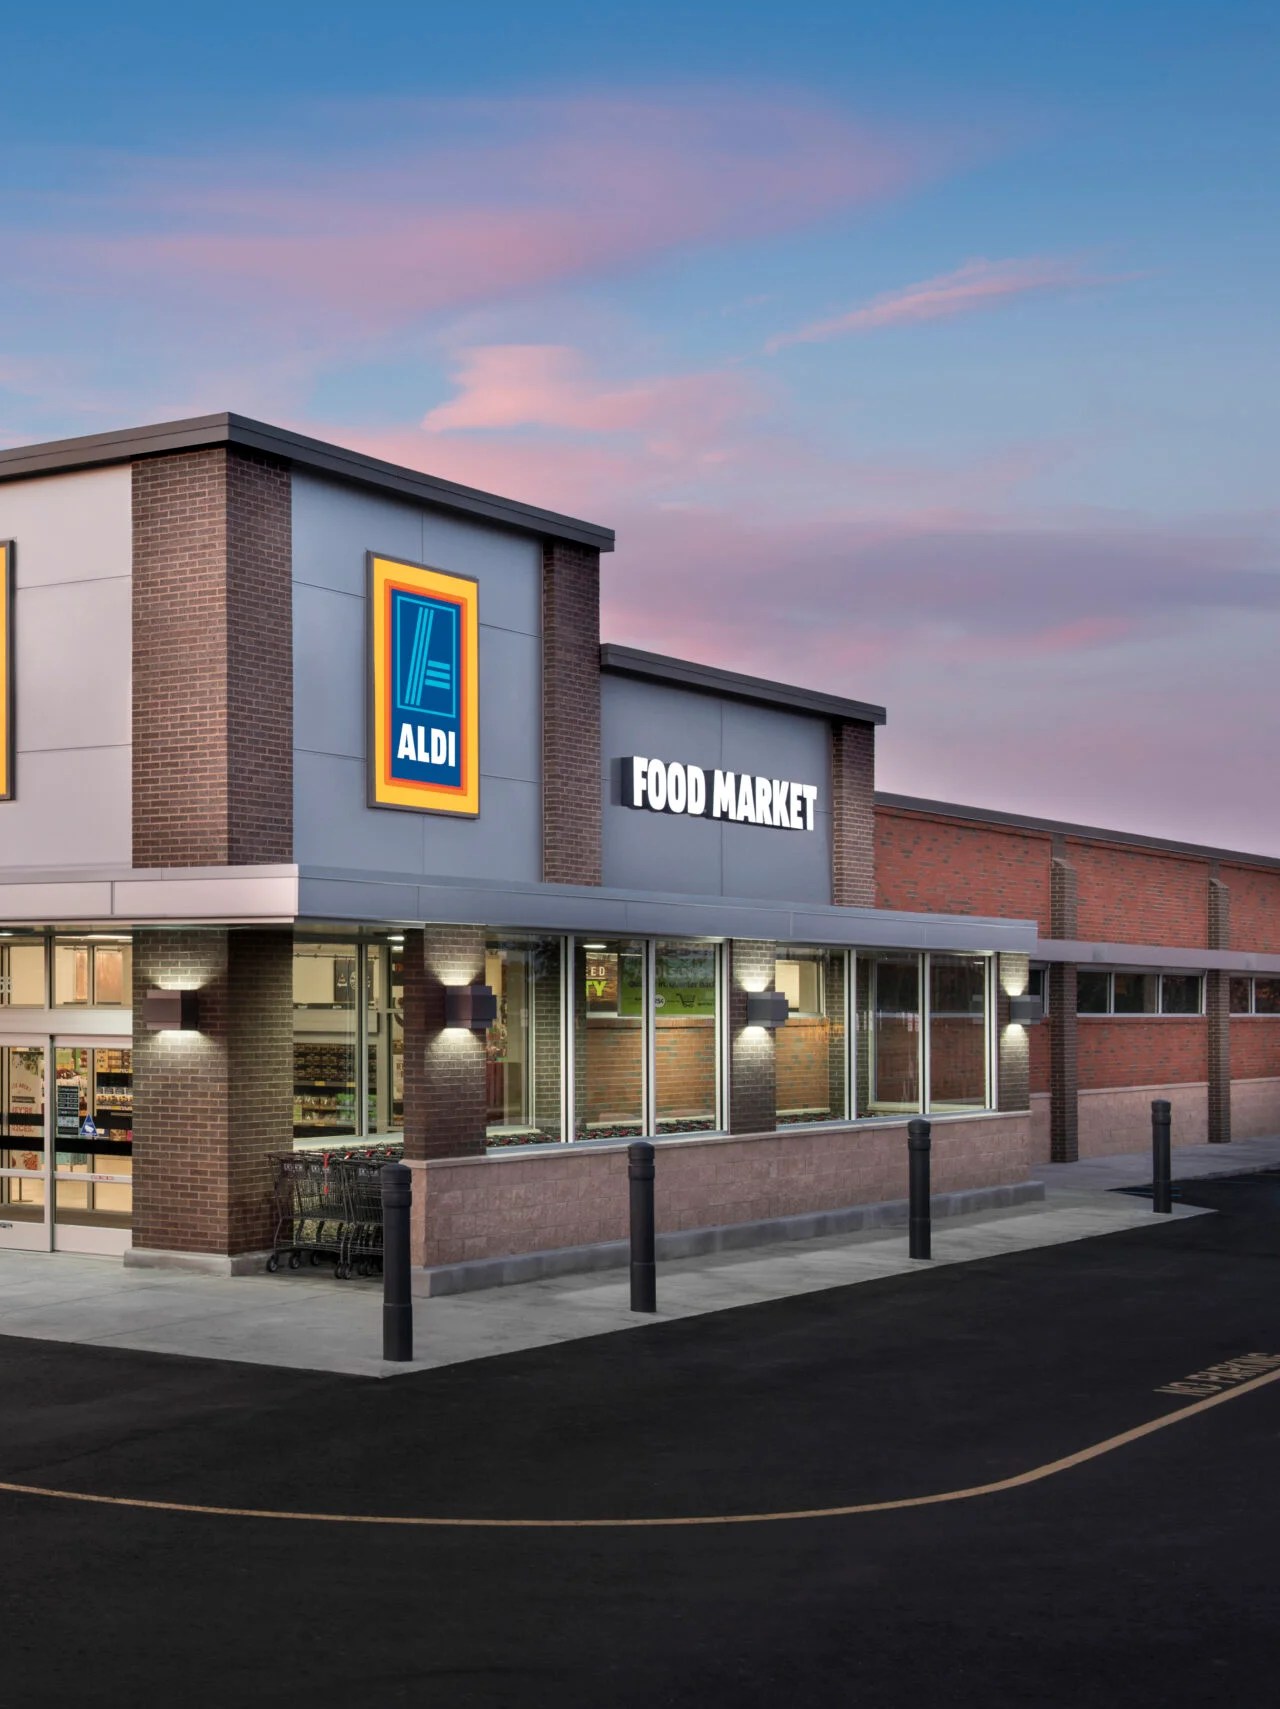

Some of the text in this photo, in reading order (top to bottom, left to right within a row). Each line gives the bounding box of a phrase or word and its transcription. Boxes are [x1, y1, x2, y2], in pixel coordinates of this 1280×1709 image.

[396, 722, 456, 768] ALDI
[632, 755, 818, 832] FOOD MARKET
